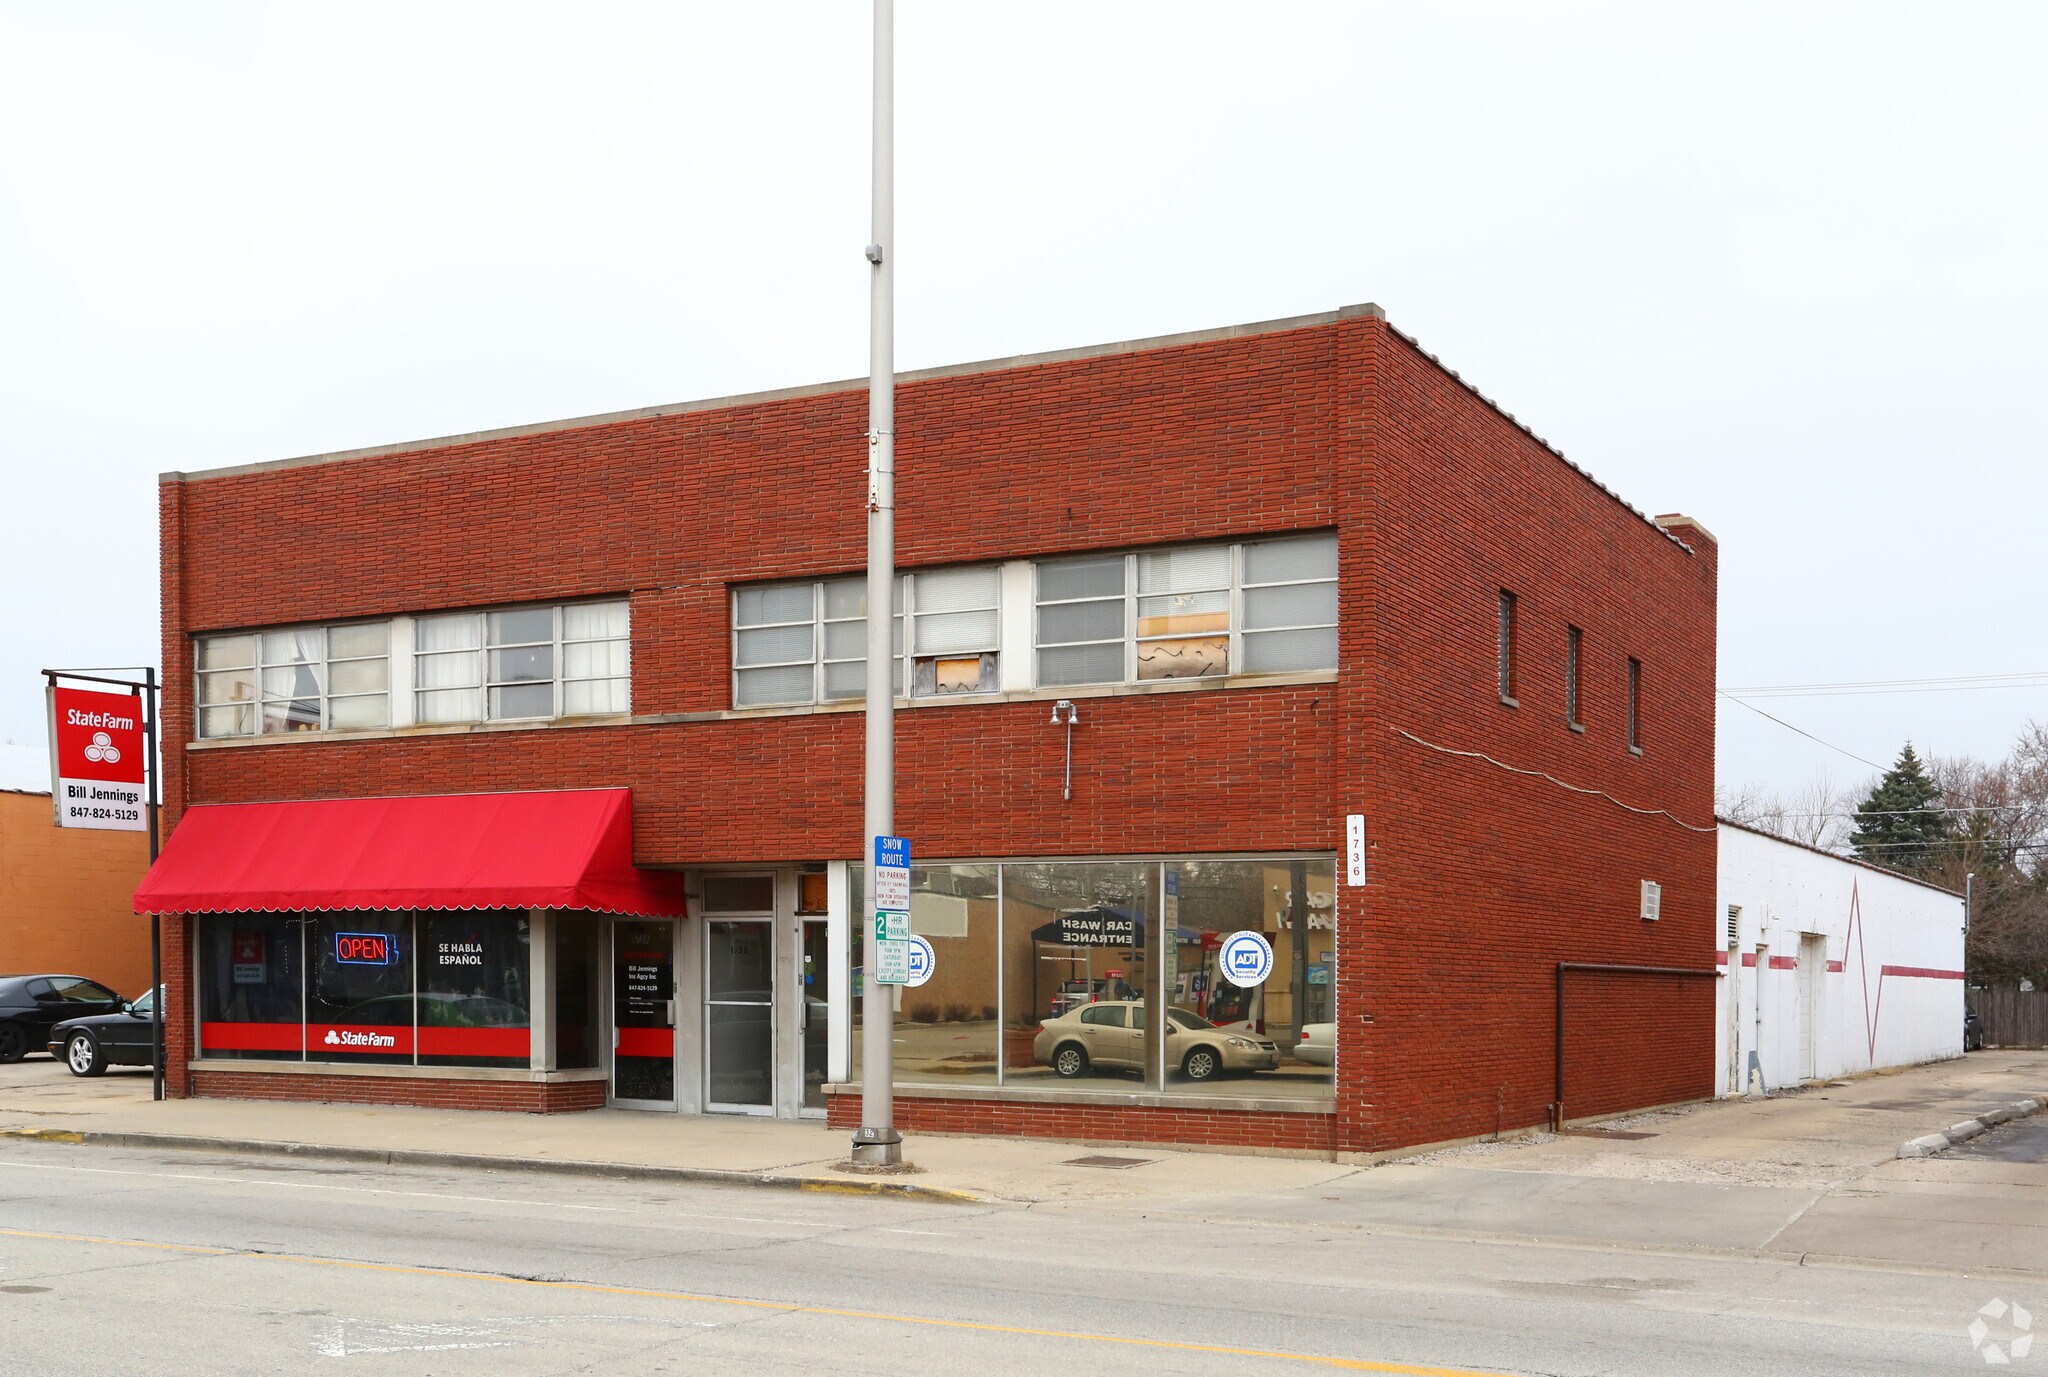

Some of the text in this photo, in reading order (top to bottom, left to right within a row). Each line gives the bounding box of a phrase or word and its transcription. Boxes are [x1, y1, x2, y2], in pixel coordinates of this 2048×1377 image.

[68, 785, 139, 804] Bill Jennings
[70, 806, 138, 821] 847-824-5129
[882, 837, 903, 850] SNOW
[881, 853, 903, 866] ROUTE
[878, 871, 907, 880] NO PARKING
[876, 916, 885, 934] 2
[887, 927, 907, 937] PARKING
[339, 938, 385, 959] OPEN
[438, 943, 483, 953] SE HABLA
[439, 953, 483, 965] ESPAÑOL
[1235, 953, 1258, 965] ADT
[637, 965, 658, 973] Jennings
